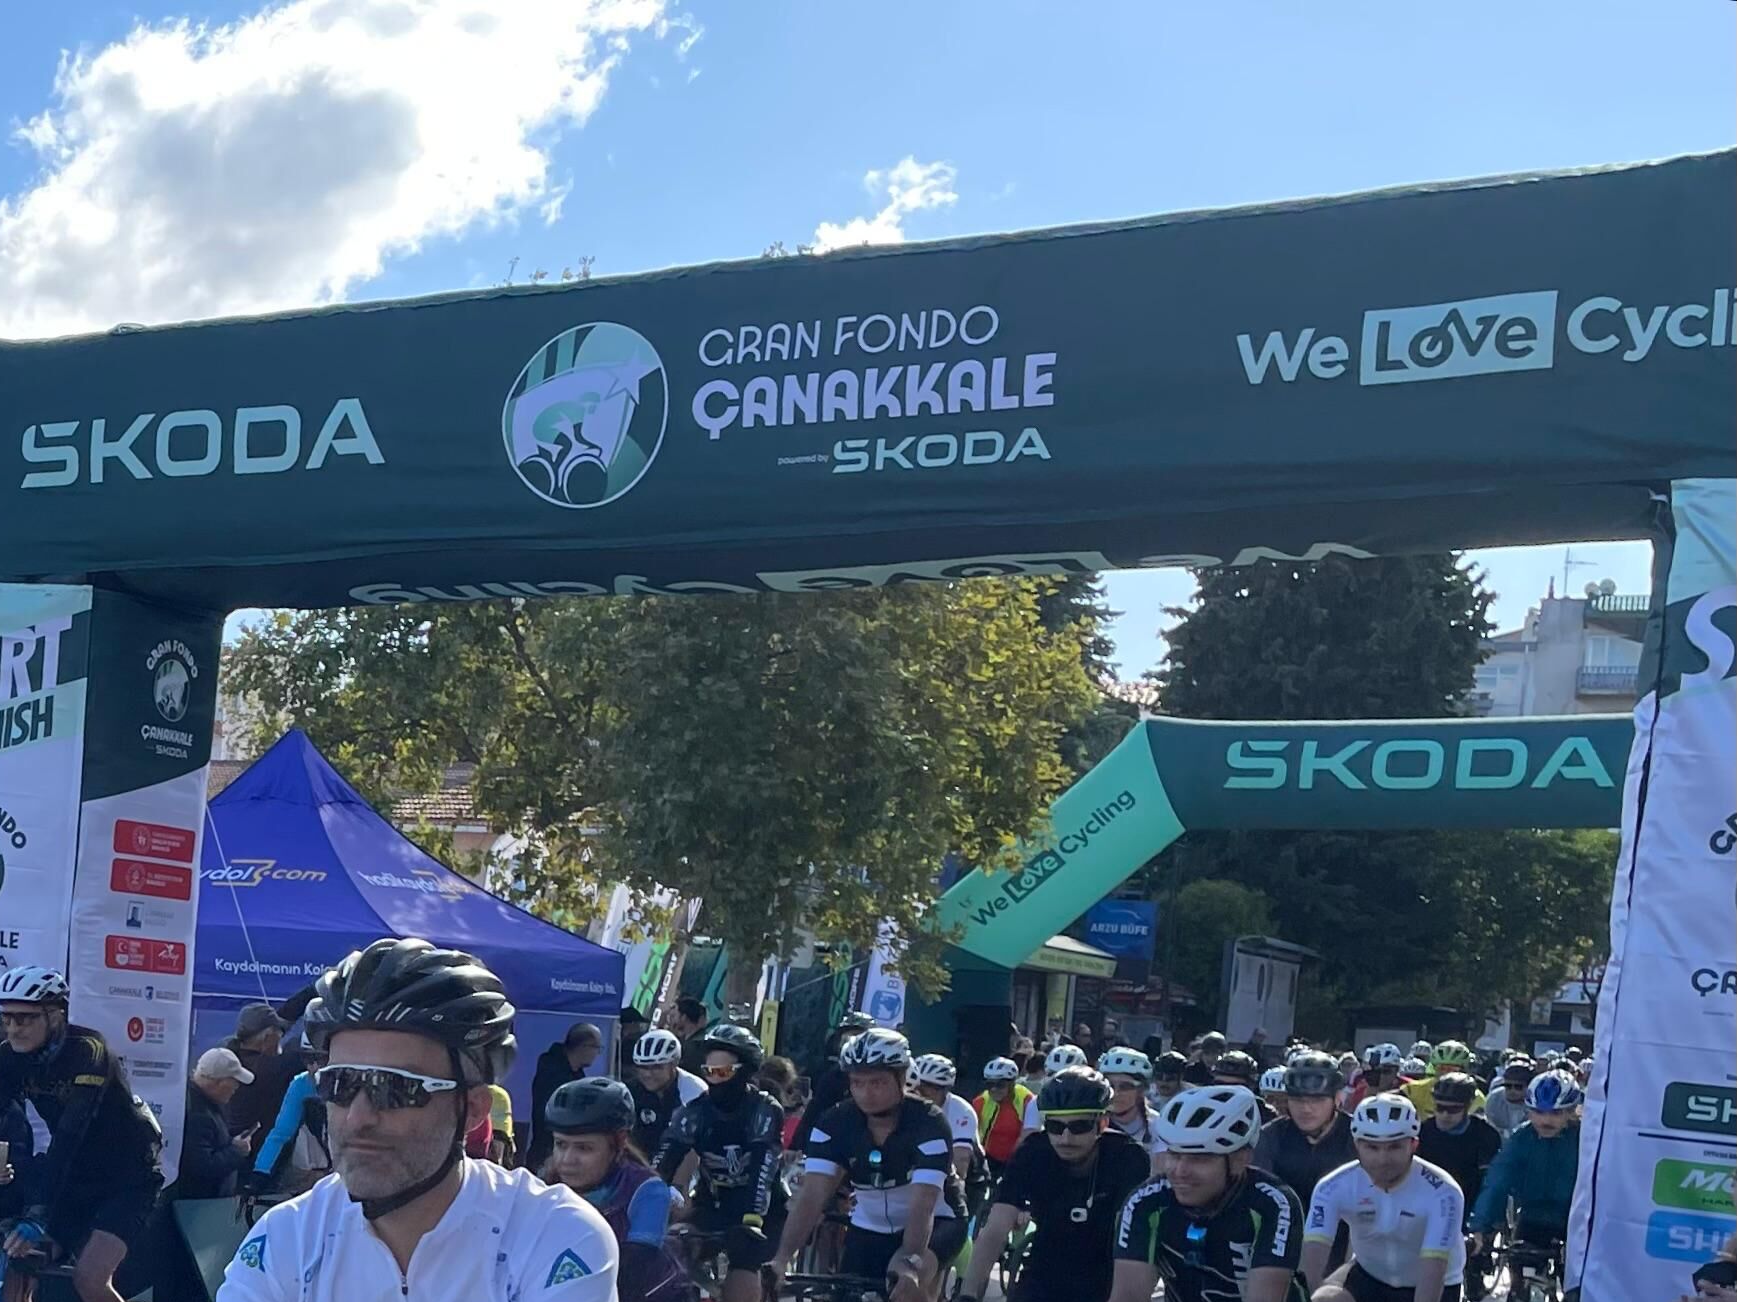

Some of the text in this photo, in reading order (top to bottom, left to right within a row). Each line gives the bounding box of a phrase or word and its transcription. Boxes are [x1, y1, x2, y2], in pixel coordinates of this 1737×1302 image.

[698, 304, 1000, 367] GRAN FONDO
[1236, 327, 1350, 385] We
[1373, 306, 1538, 373] Love
[691, 352, 1058, 440] ÇANAKKALE
[19, 397, 386, 490] SKODA
[831, 426, 1052, 474] SKODA
[146, 639, 199, 679] GRAN FONDO
[140, 724, 194, 748] ÇANAKKALE
[155, 744, 189, 759] SKODA
[1223, 736, 1616, 790] SKODA
[969, 789, 1137, 926] We Love Cycling
[1090, 921, 1150, 936] ARZU BÜFE
[1420, 1166, 1444, 1190] VISA
[1311, 1205, 1325, 1229] VISA
